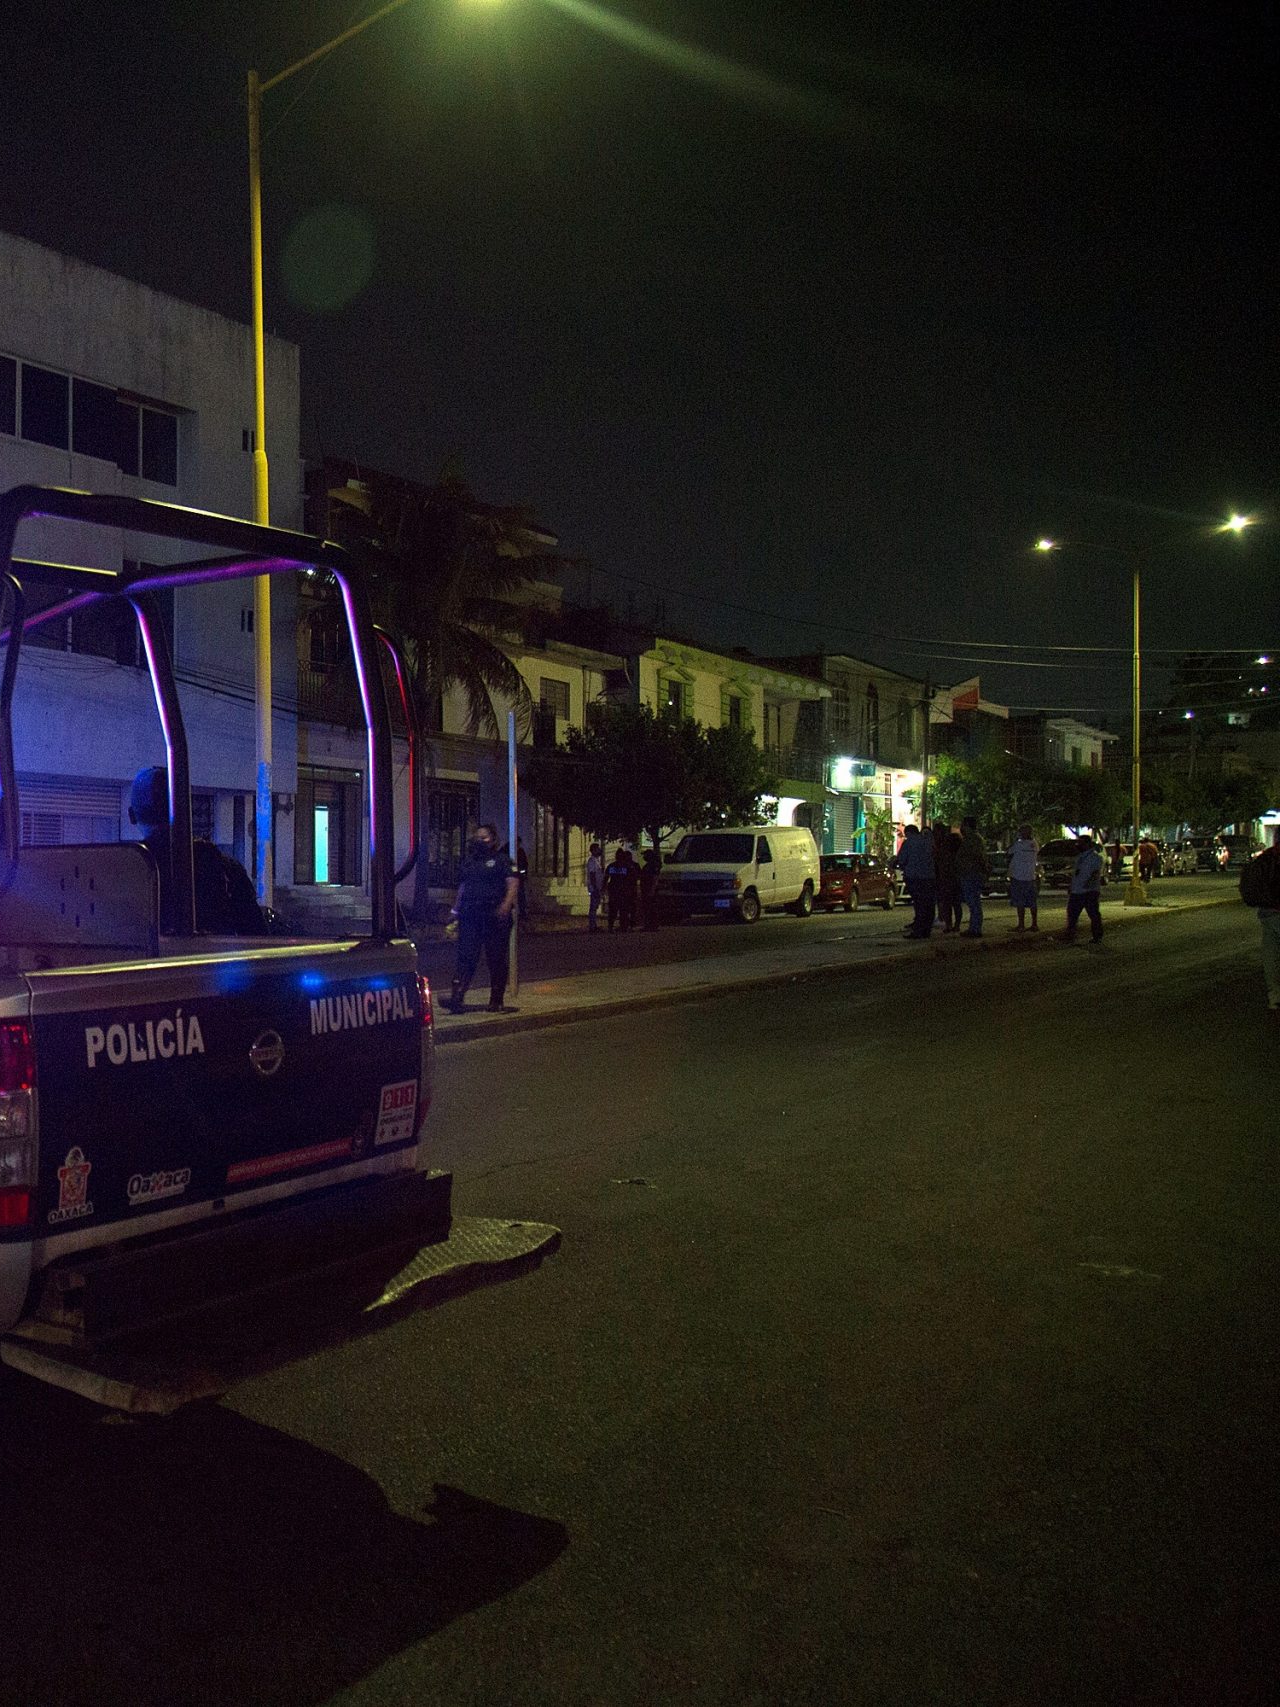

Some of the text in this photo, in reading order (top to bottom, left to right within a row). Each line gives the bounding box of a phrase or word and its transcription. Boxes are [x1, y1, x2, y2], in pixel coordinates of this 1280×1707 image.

[85, 986, 414, 1068] POLICÍA MUNICIPAL
[384, 1087, 412, 1110] 911
[128, 1169, 191, 1197] Oaxaca
[48, 1203, 94, 1223] OAXACA
